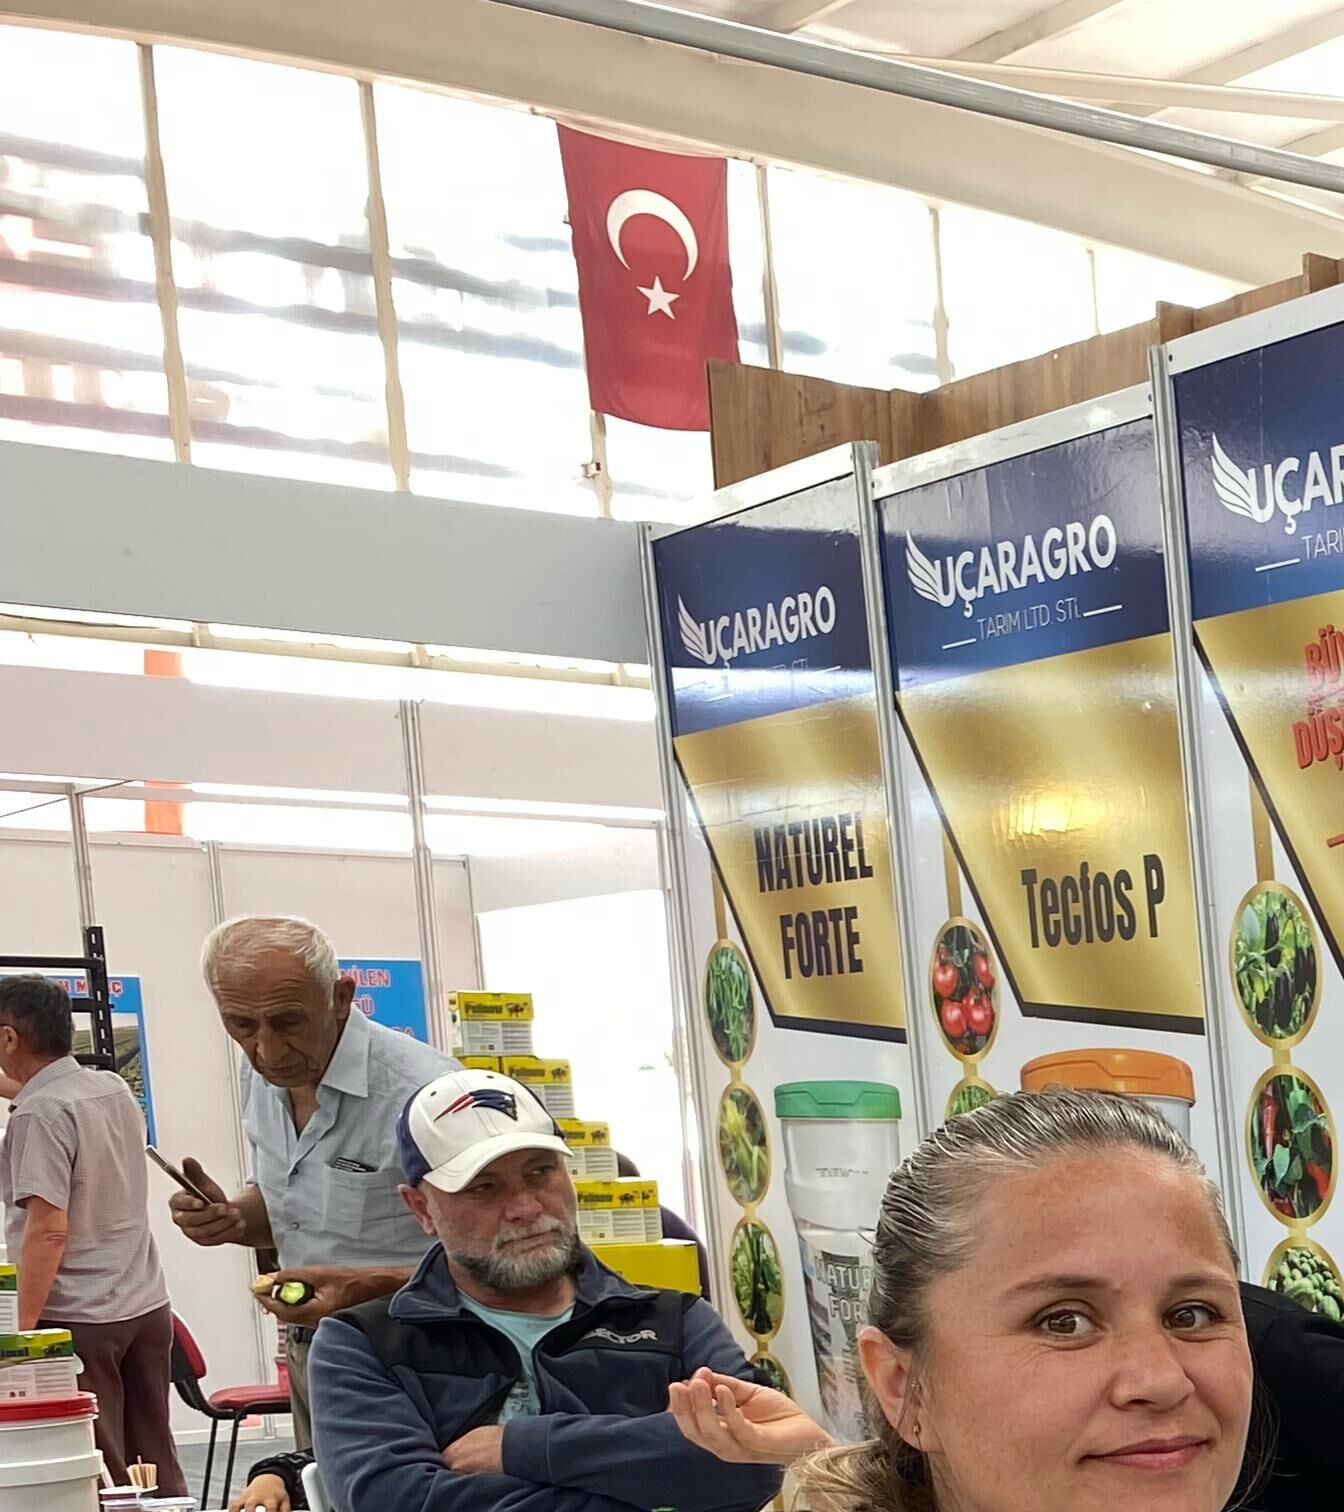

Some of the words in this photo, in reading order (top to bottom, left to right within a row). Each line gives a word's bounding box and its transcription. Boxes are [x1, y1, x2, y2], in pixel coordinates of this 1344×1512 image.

[932, 514, 1117, 617] UÇARAGRO
[700, 585, 836, 669] UÇARAGRO
[977, 609, 1022, 641] TARIM
[1023, 600, 1054, 634] LTD.
[755, 811, 873, 893] NATUREL
[780, 905, 863, 979] FORTE
[1021, 861, 1136, 949] Tecfos
[1143, 853, 1165, 938] P
